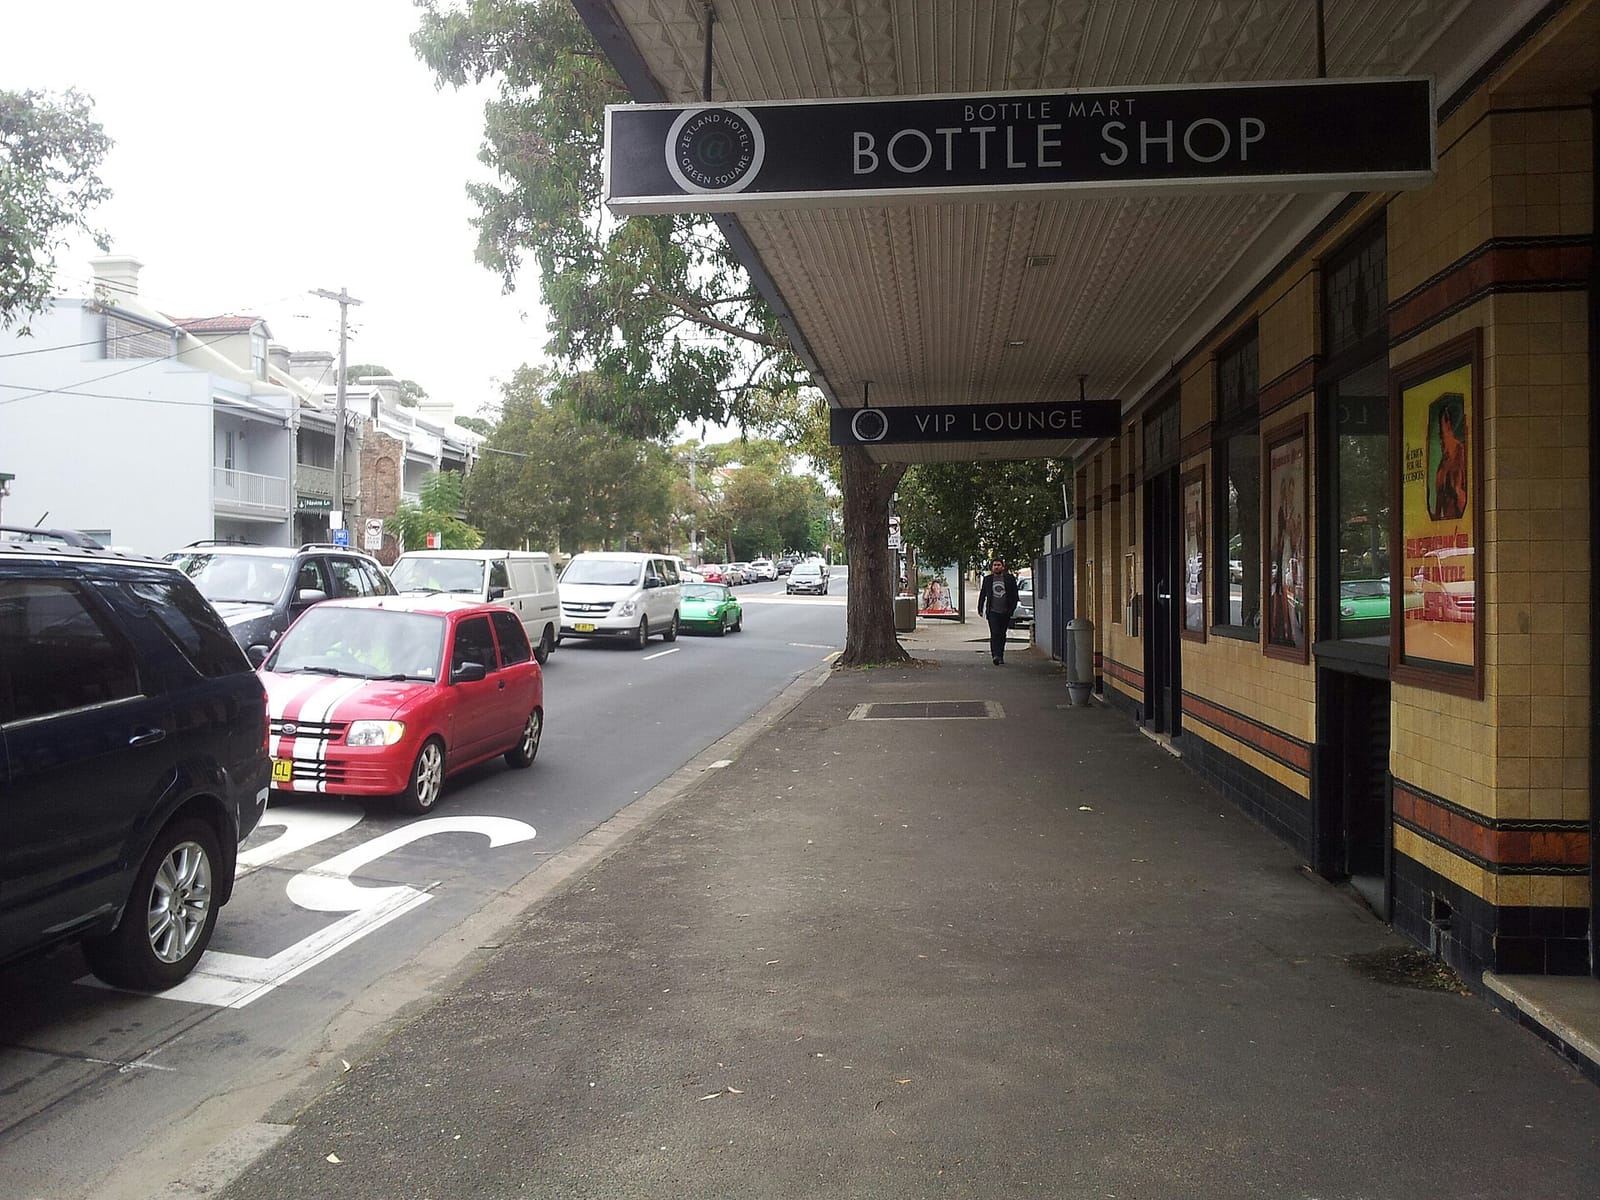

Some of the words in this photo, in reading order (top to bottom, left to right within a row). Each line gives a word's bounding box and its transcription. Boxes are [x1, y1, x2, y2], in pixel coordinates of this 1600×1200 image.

[964, 102, 1051, 121] BOTTLE
[1068, 99, 1136, 118] MART
[681, 114, 720, 149] ZETLAND
[724, 116, 749, 148] HOTEL
[853, 123, 1062, 175] BOTTLE
[1100, 117, 1266, 166] SHOP
[682, 158, 711, 184] GREEN
[714, 155, 750, 184] SQUARE
[915, 414, 956, 432] VIP
[973, 410, 1082, 431] LOUNGE
